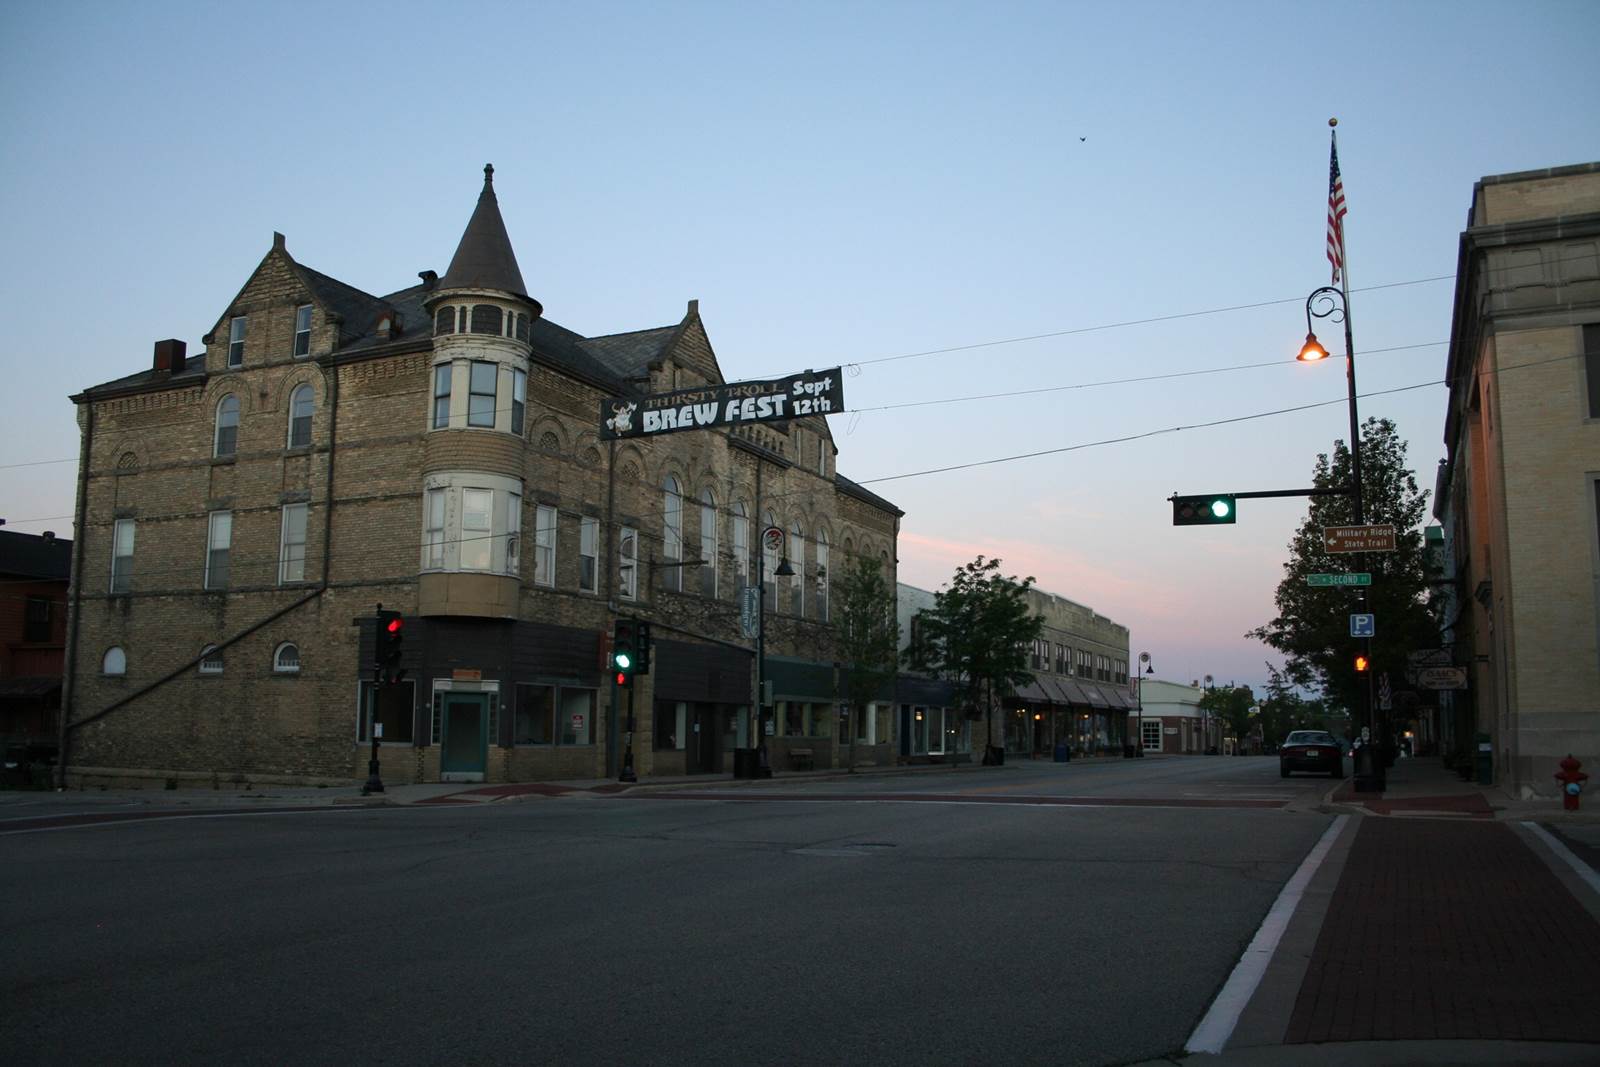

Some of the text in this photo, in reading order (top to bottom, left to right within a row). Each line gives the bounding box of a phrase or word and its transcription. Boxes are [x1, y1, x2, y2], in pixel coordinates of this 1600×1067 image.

[793, 376, 832, 397] Sept
[646, 384, 785, 408] THIRSTY TROLL
[643, 394, 787, 433] BREW FEST
[793, 396, 831, 416] 12th
[1336, 528, 1393, 538] Military Ridge
[1344, 539, 1388, 548] State Trail
[1329, 575, 1358, 585] SECOND
[1355, 616, 1369, 630] P
